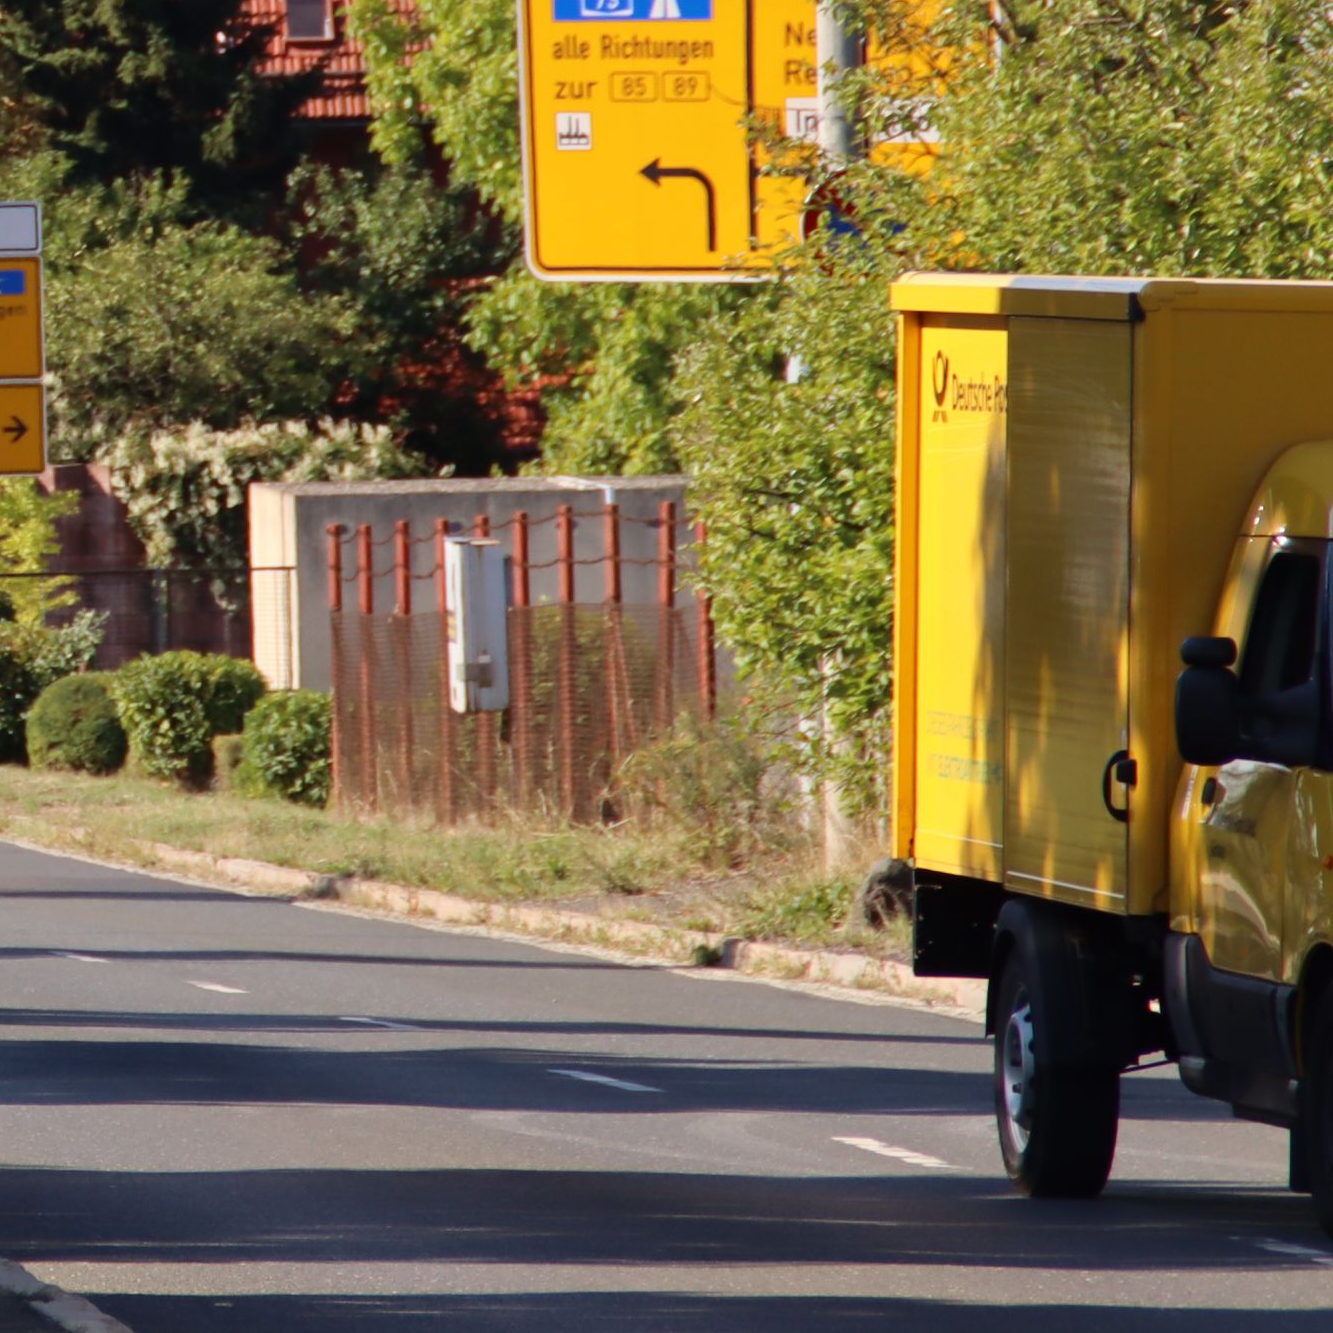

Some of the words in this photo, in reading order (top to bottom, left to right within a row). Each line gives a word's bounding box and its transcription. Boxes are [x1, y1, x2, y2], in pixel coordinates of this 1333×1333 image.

[553, 34, 590, 60] alle
[600, 34, 715, 66] Richtungen
[555, 80, 597, 100] zur
[622, 76, 647, 96] 85
[673, 76, 698, 96] 89
[952, 373, 992, 412] Deutsche
